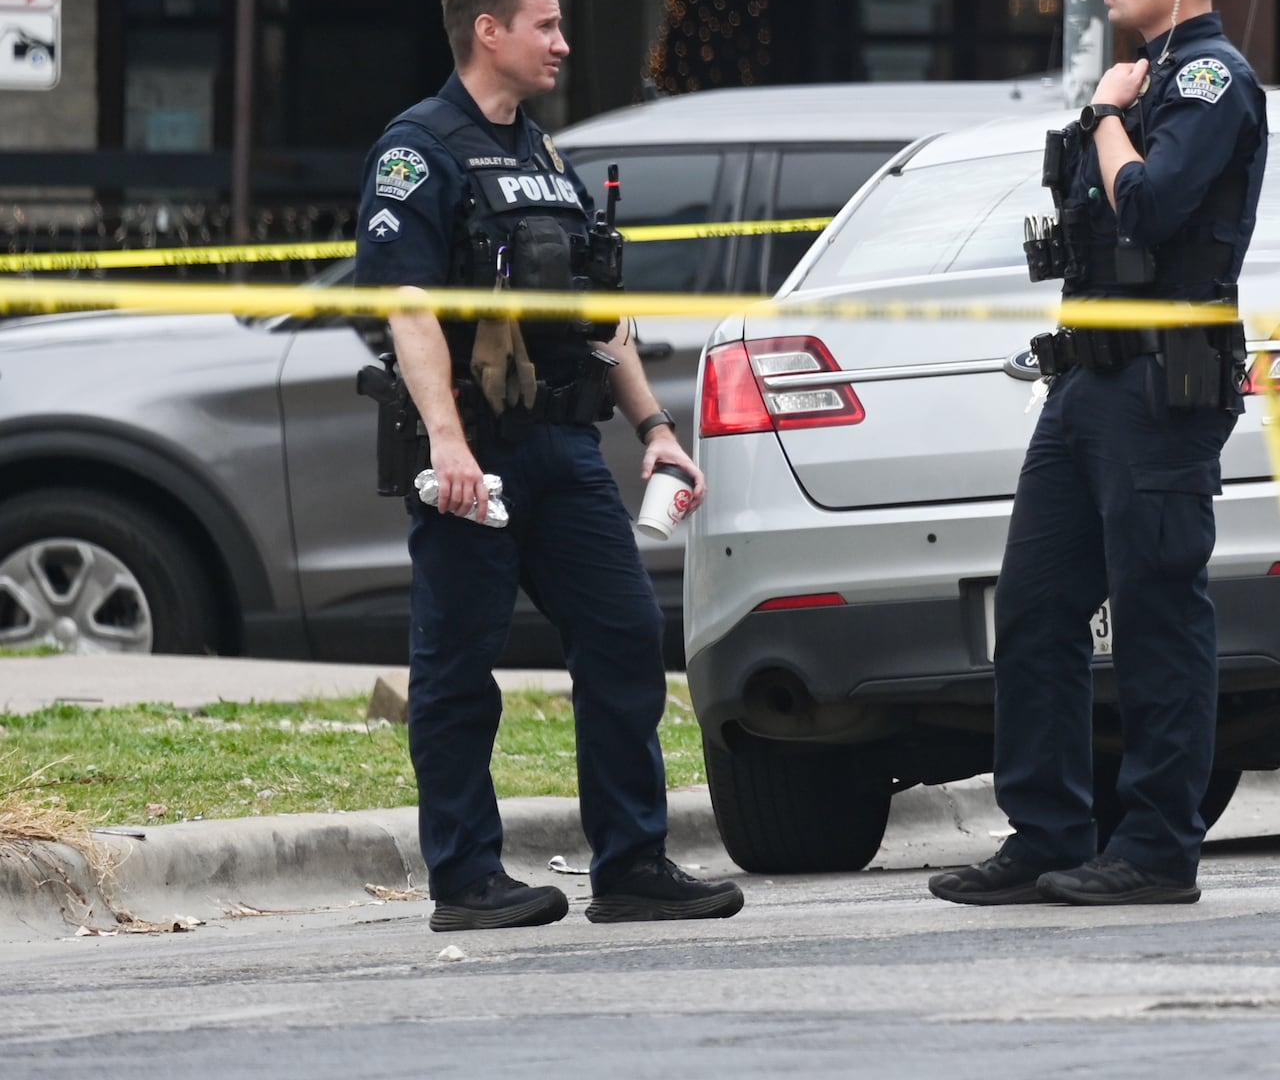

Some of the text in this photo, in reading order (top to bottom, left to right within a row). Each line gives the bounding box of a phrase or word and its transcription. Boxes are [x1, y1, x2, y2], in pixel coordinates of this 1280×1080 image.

[382, 150, 427, 174] POLICE
[468, 156, 502, 166] BRADLEY
[378, 185, 407, 197] AUSTIN
